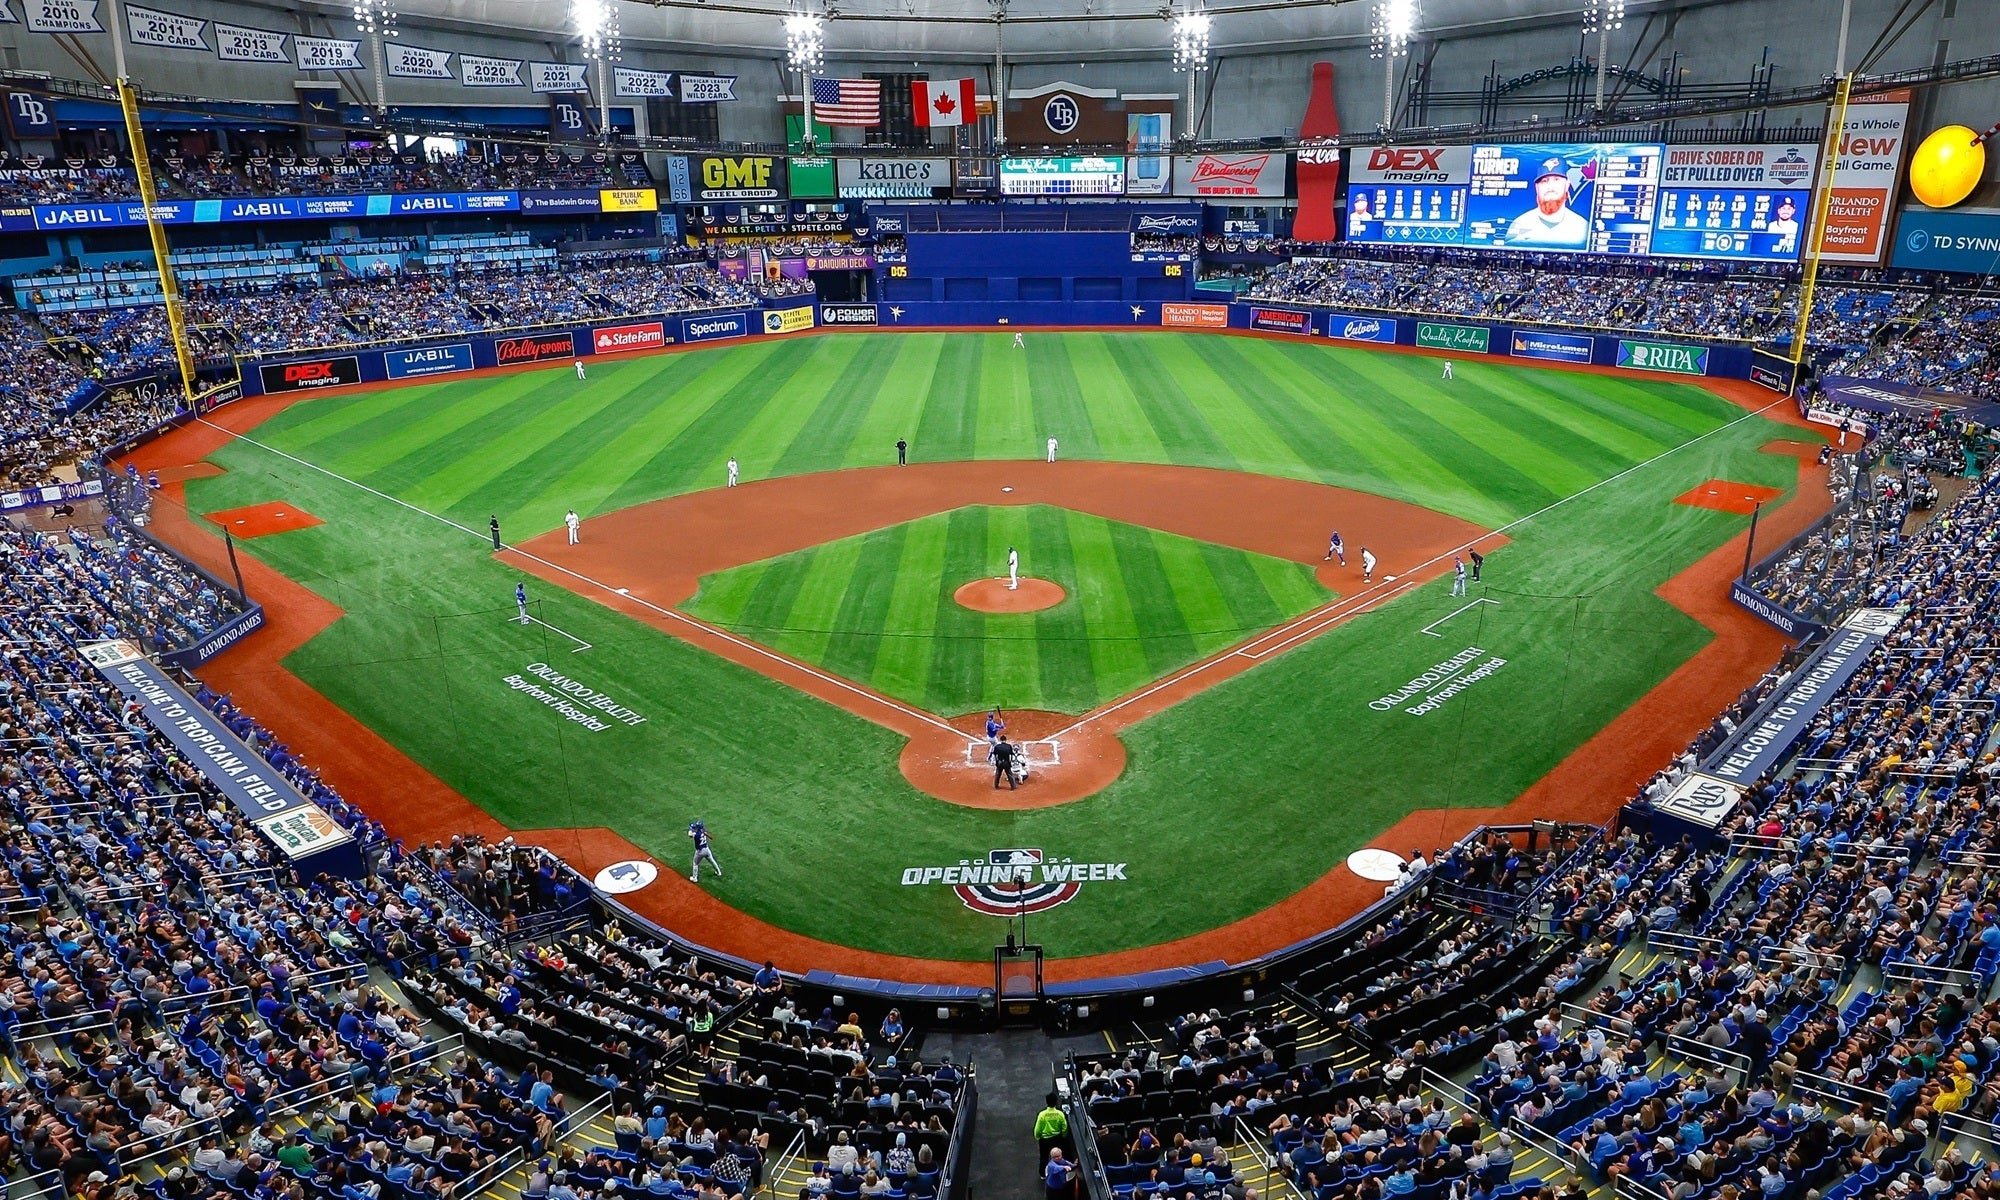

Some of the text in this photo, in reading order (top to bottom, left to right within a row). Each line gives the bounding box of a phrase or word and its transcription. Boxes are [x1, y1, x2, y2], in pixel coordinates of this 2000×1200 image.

[43, 7, 79, 20] 2010
[129, 11, 199, 28] AMERICAN LEAGUE
[36, 19, 91, 30] CHAMPIONS
[148, 21, 184, 36] 2011
[137, 30, 197, 46] WILD CARD
[218, 29, 281, 41] AMERICAN LEAGUE
[234, 37, 268, 50] 2013
[225, 46, 279, 60] WILD CARD
[311, 47, 343, 58] 2019
[303, 58, 353, 67] WILD CARD
[402, 56, 434, 68] 2020
[394, 65, 444, 76] CHAMPIONS
[475, 66, 506, 77] 2020
[544, 72, 570, 81] 2021
[467, 75, 516, 84] CHAMPIONS
[628, 78, 657, 88] 2022
[621, 86, 665, 95] WILD CARD
[693, 84, 720, 93] 2023
[10, 93, 49, 126] TB
[556, 104, 582, 128] TB
[1051, 102, 1074, 127] TB
[1851, 119, 1900, 130] a Whole
[1828, 133, 1897, 155] New
[1367, 149, 1445, 170] DEX
[1670, 150, 1764, 165] DRIVE SOBER OR
[672, 160, 684, 169] 42
[1197, 163, 1260, 177] Budweiser
[1473, 158, 1519, 175] TURNER
[1852, 160, 1895, 171] Game.
[675, 174, 685, 184] 12
[703, 158, 773, 188] GMF
[1384, 170, 1449, 183] imaging
[1665, 167, 1764, 181] GET PULLED OVER
[613, 191, 645, 199] REPUBLIC
[675, 188, 688, 200] 66
[1232, 187, 1244, 195] FOR
[1245, 187, 1259, 195] YOU.
[401, 197, 454, 209] JABIL
[577, 199, 599, 208] Group
[1828, 196, 1880, 206] ORLANDO
[44, 209, 113, 224] JABIL
[232, 203, 292, 217] JABIL
[1829, 206, 1871, 216] HEALTH
[705, 226, 720, 234] WE
[791, 224, 843, 232] STPETE.ORG
[876, 223, 902, 231] PORCH
[1825, 225, 1868, 235] Bayfront
[1825, 235, 1865, 244] Hospital
[1933, 236, 1953, 249] TD
[818, 258, 848, 268] DAIQUIRI
[849, 258, 868, 268] DECK
[1165, 265, 1181, 276] 0:05
[1165, 307, 1199, 315] ORLANDO
[1202, 309, 1225, 317] Bayfront
[1258, 311, 1304, 323] AMERICAN
[1169, 314, 1195, 322] HEALTH
[690, 321, 737, 335] Spectrum
[1344, 320, 1380, 338] Culver's
[1420, 326, 1485, 349] Quality Roofing
[499, 337, 572, 360] Bally SPORTS
[1530, 341, 1588, 353] MicroLumen
[404, 349, 455, 363] JABIL
[1650, 347, 1694, 370] RIPA
[285, 362, 333, 381] DEX
[299, 375, 340, 387] imaging
[134, 383, 160, 400] 162
[1733, 588, 1794, 632] RAYMOND JAMES
[199, 612, 263, 660] RAYMOND JAMES
[1368, 646, 1486, 711] ORLANDO HEALTH
[1405, 656, 1508, 716] Bayfront Hospital
[526, 662, 648, 725] ORLANDO HEALTH
[503, 674, 612, 732] Bayfront Hospital
[1716, 631, 1869, 778] WELCOME TO TROPICANA FIELD
[117, 662, 288, 812] WELCOME TO TROPICANA FIELD
[285, 813, 321, 843] Tropicana
[959, 858, 985, 866] 20
[901, 863, 1128, 886] OPENING WEEK
